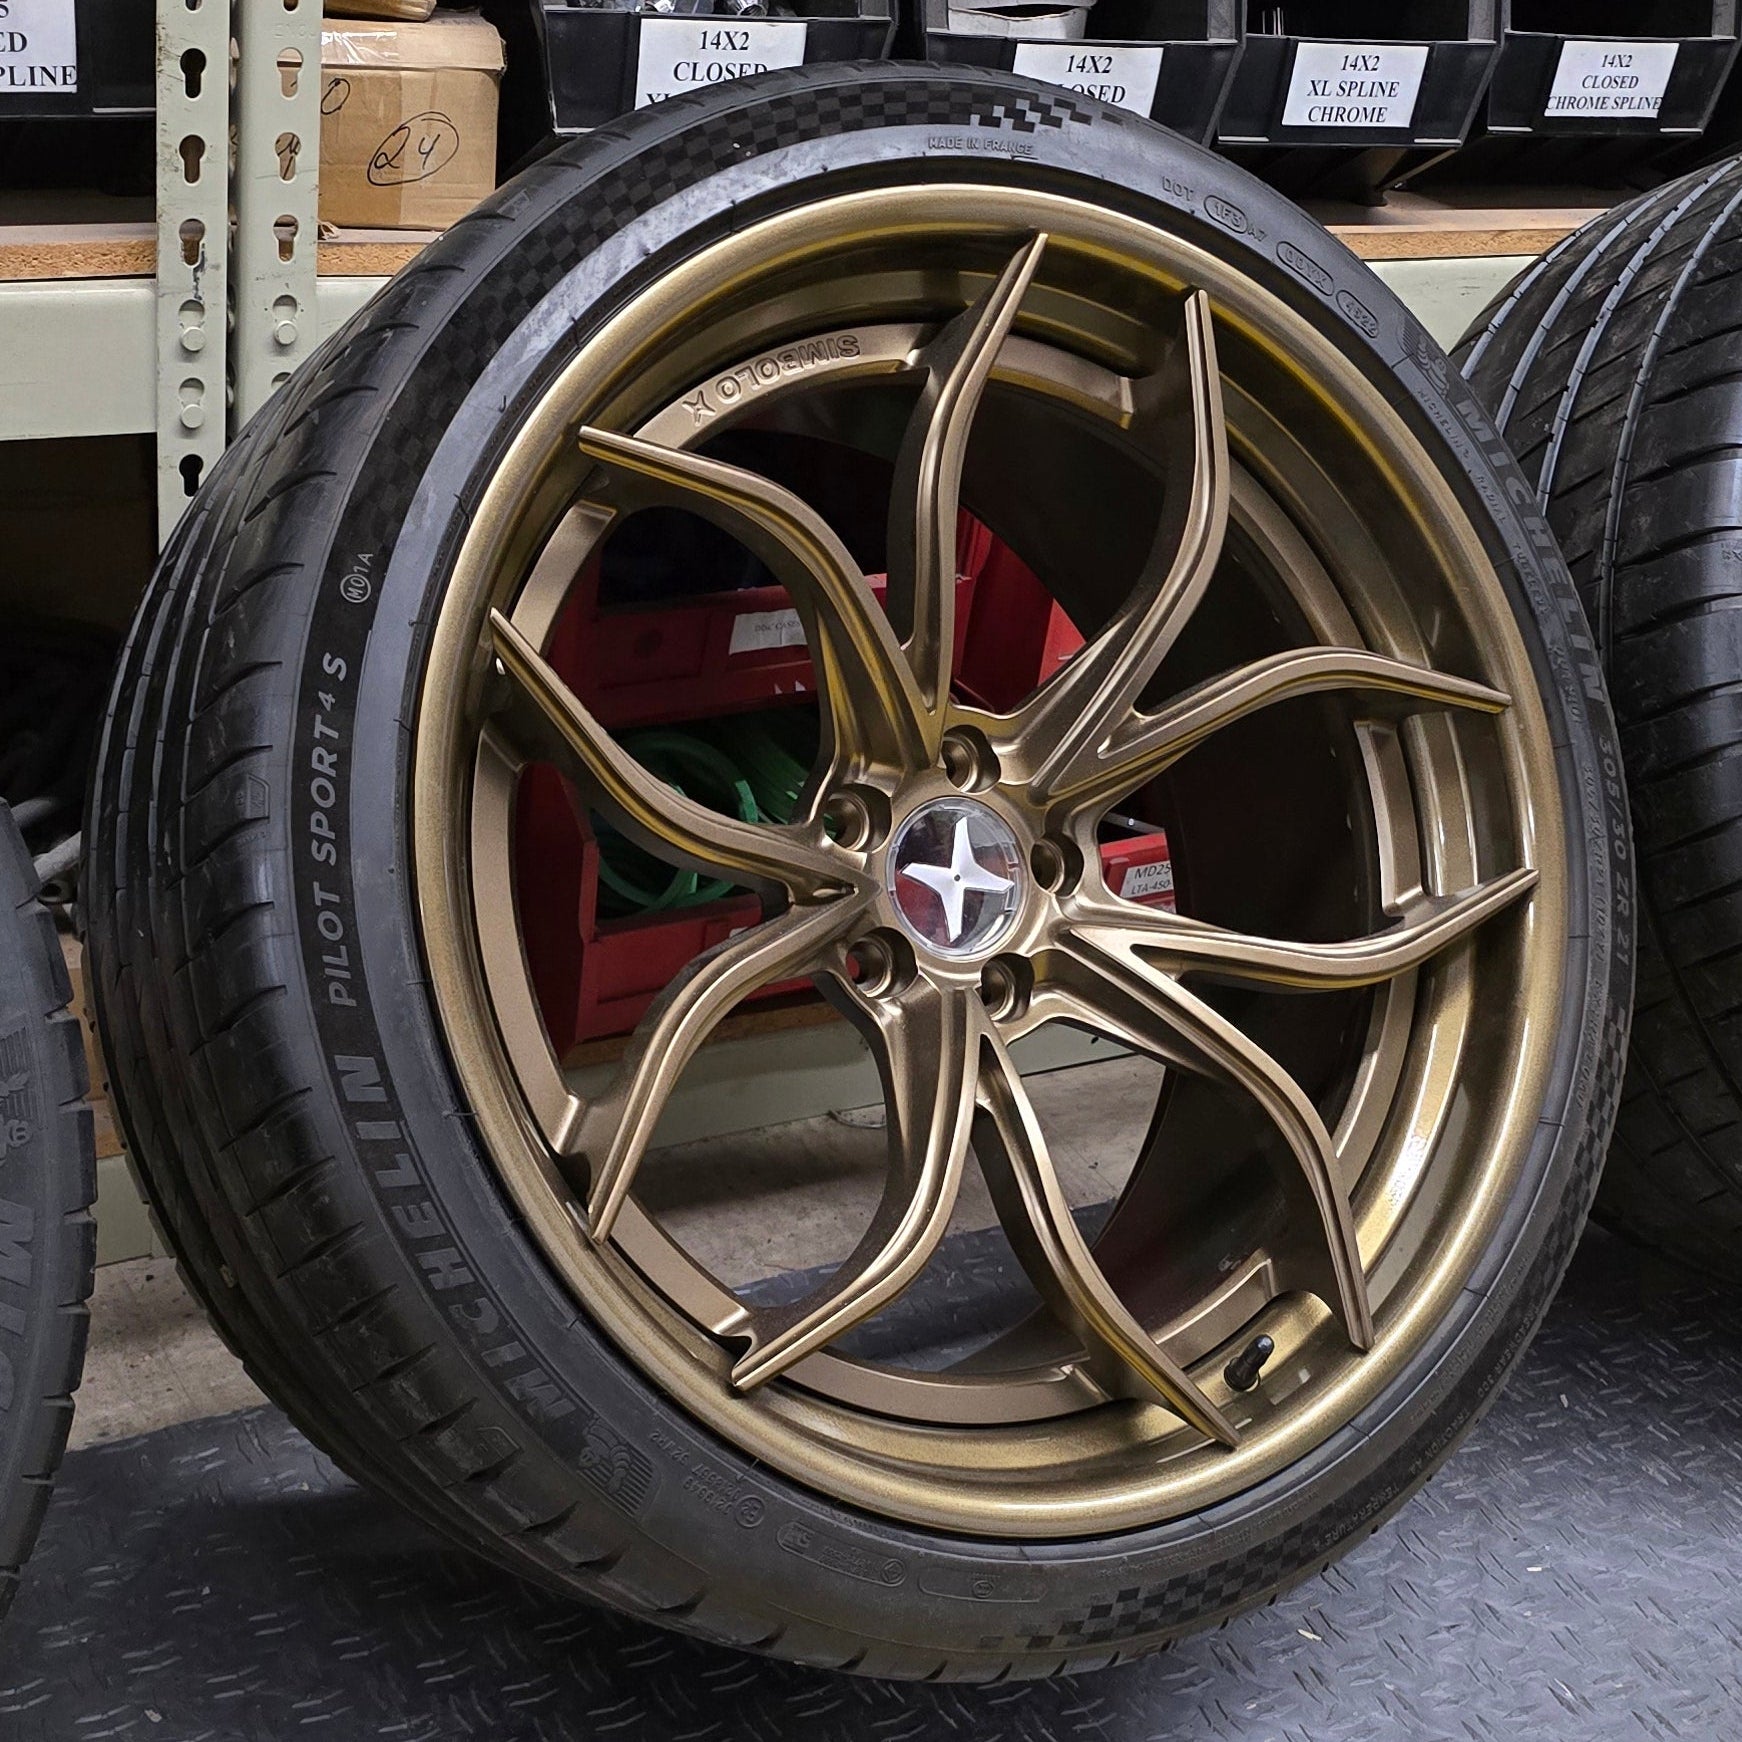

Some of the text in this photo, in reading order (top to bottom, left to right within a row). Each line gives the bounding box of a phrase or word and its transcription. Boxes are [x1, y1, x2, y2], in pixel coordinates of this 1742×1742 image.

[700, 30, 750, 50] 14X2
[1066, 54, 1113, 74] 14X2
[1341, 54, 1380, 71] 14X2
[1601, 54, 1633, 68] 14X2
[1307, 79, 1400, 98] XL SPLINE
[1582, 75, 1639, 89] CLOSED
[1547, 96, 1663, 110] CHROME SPLINE
[1308, 105, 1388, 123] CHROME
[374, 126, 440, 170] 24
[928, 136, 1033, 155] MADE IN FRANCE
[1162, 176, 1194, 201] DOT
[715, 334, 861, 404] SIMBOLO
[1456, 402, 1606, 702] MICHELIN
[310, 651, 357, 1008] PILOT SPORT 4 S
[1600, 736, 1630, 965] 305/30 ZR 21
[334, 1054, 578, 1421] MICHELIN
